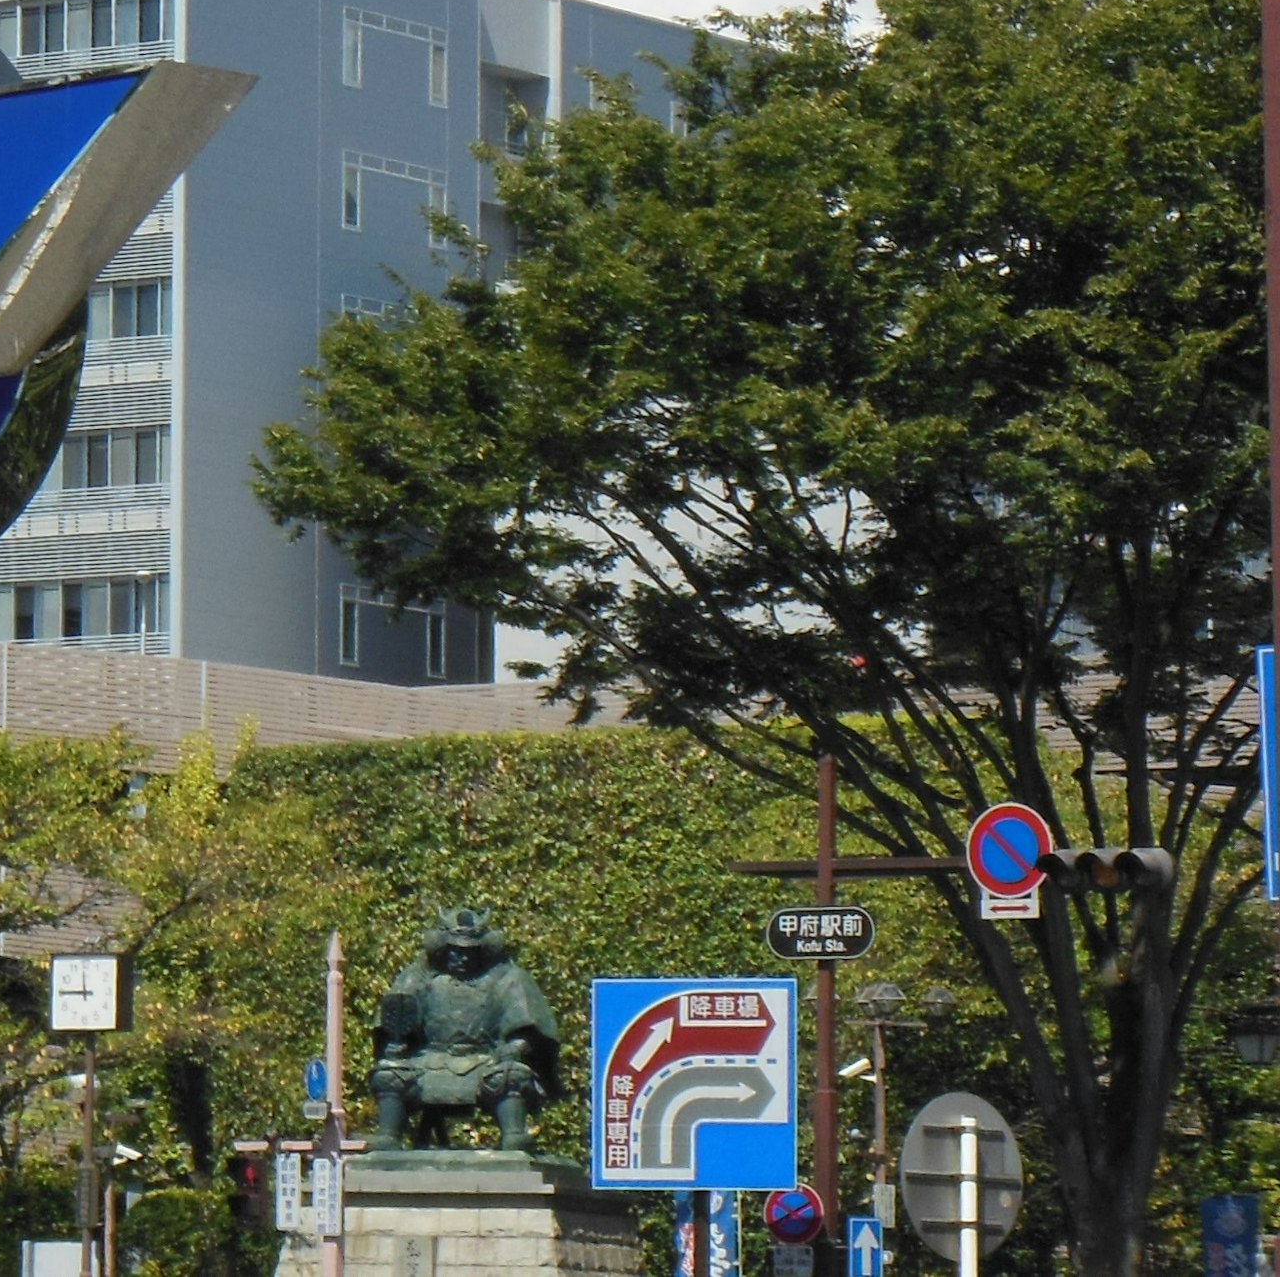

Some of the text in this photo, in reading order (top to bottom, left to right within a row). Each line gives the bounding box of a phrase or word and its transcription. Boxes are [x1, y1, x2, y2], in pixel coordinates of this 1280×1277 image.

[778, 914, 863, 937] 甲府駅前
[796, 938, 847, 953] Kofu Sta.
[690, 995, 759, 1018] 降車場
[607, 1075, 634, 1167] 降車専用
